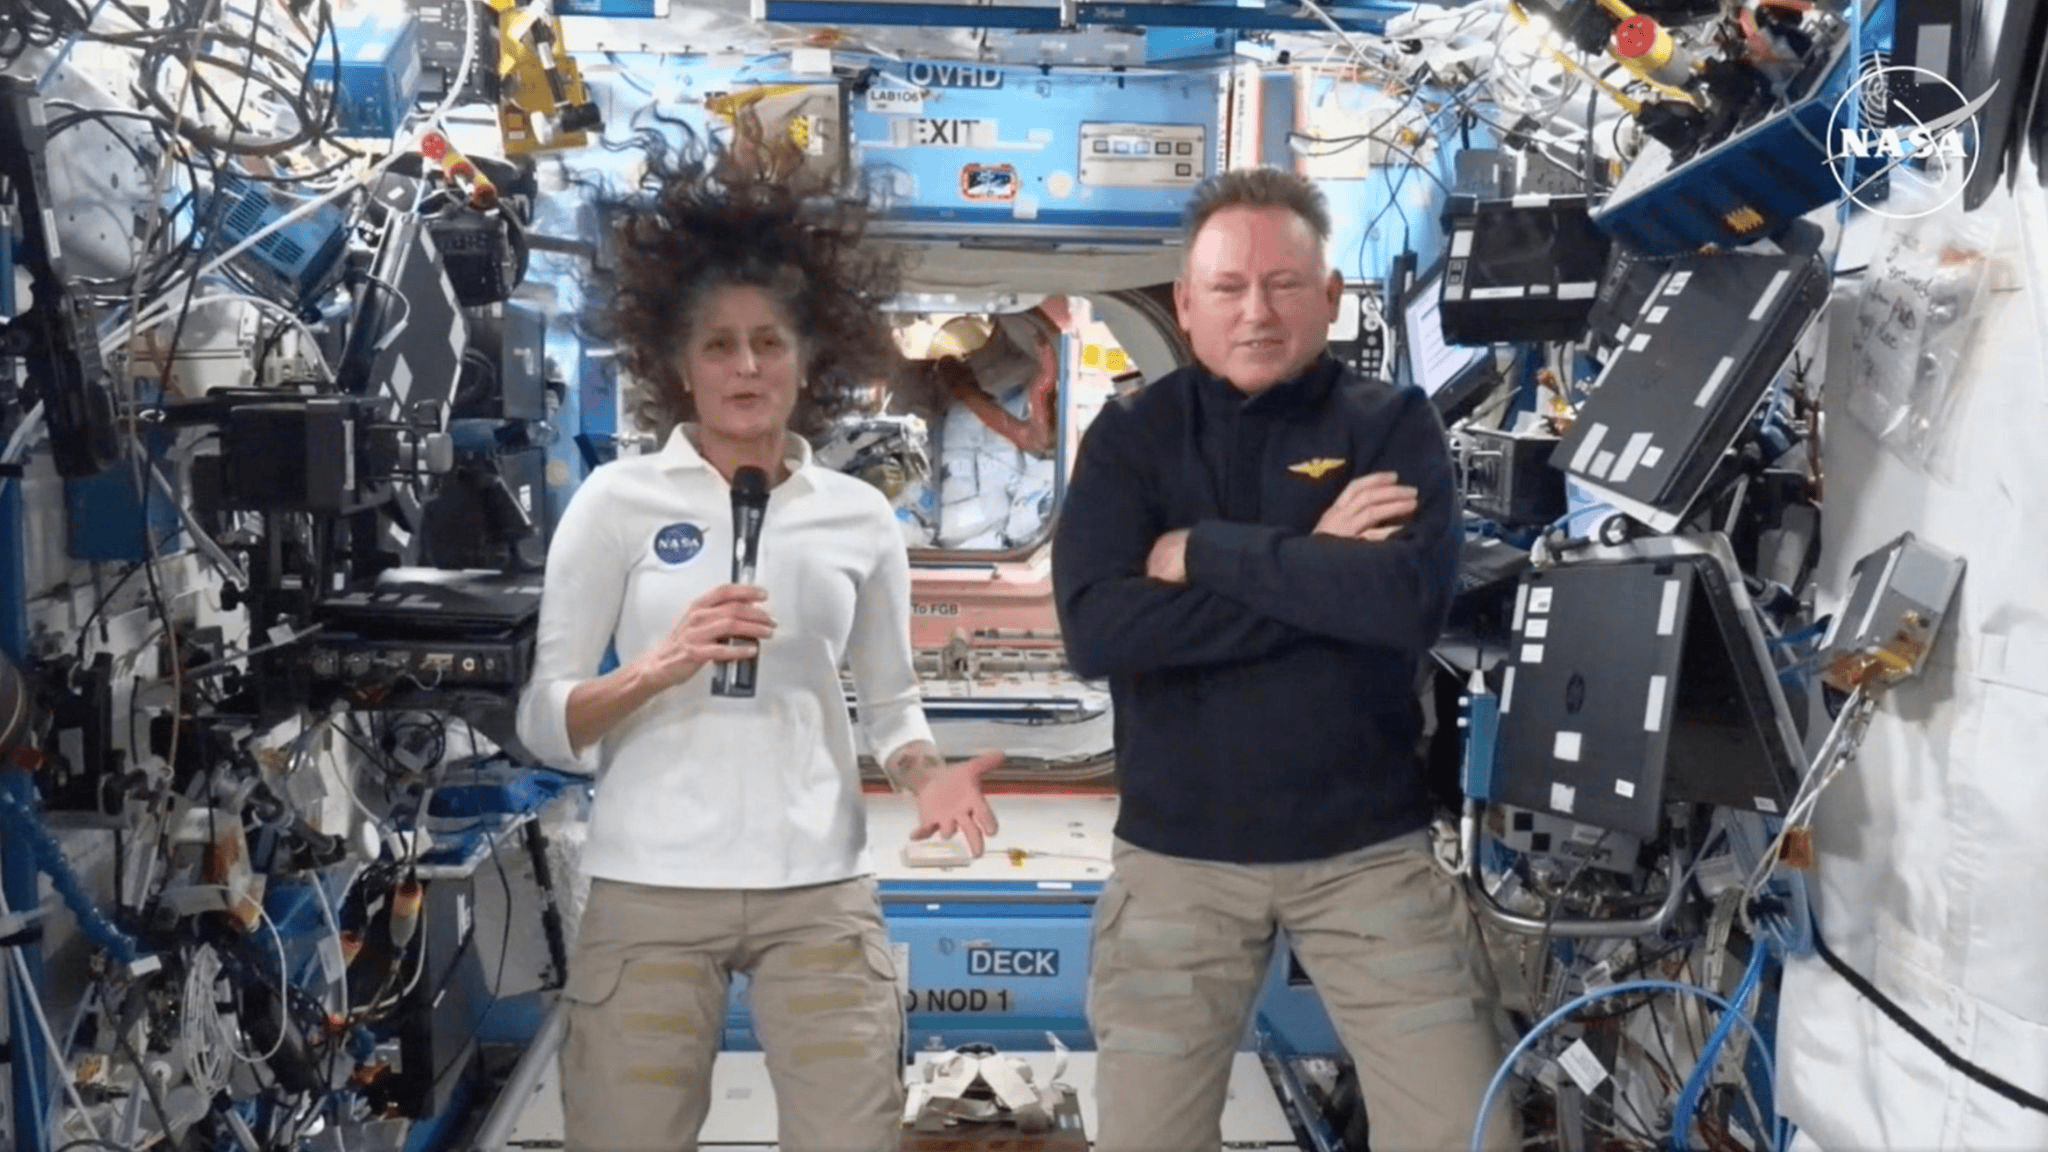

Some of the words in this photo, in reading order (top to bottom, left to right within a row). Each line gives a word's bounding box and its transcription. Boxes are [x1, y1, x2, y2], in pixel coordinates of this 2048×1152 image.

[910, 63, 1002, 88] OVHD
[912, 118, 981, 145] EXIT
[658, 537, 700, 549] NASA
[970, 950, 1056, 975] DECK
[927, 988, 988, 1012] NOD
[997, 988, 1008, 1011] 1
